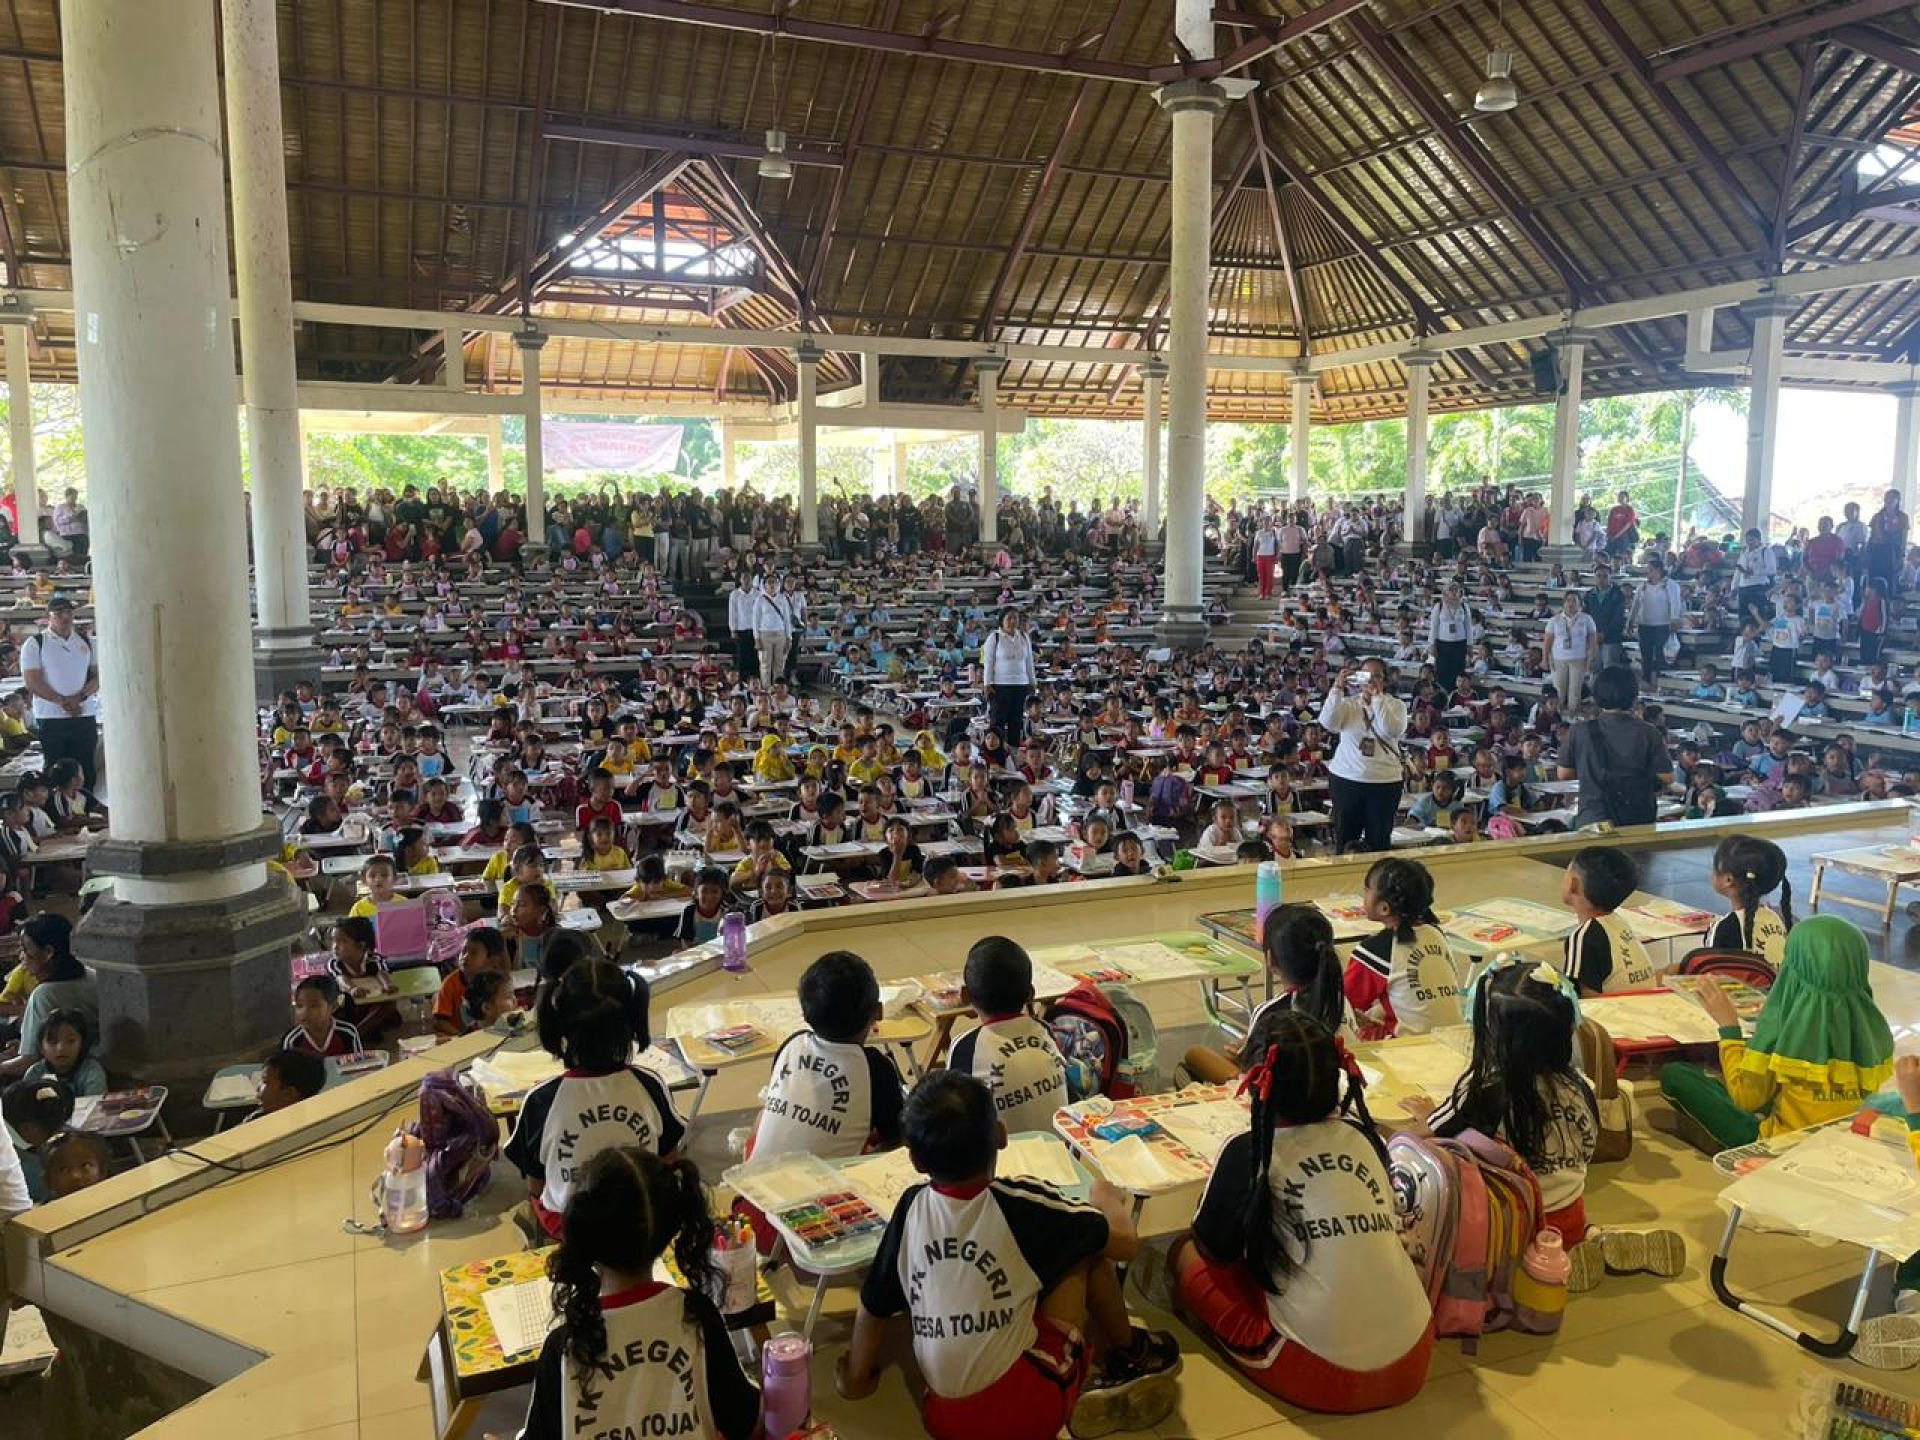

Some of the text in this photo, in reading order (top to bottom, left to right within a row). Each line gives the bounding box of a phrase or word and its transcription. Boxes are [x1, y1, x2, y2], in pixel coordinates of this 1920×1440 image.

[798, 1055, 850, 1113] NEGERI
[996, 1086, 1034, 1110] DESA
[558, 1104, 650, 1161] TK NEGERI
[792, 1104, 841, 1134] TOJAN
[1284, 1153, 1384, 1216] TK NEGERI
[1294, 1217, 1345, 1242] DESA
[910, 1238, 1012, 1305] TK NEGERI
[913, 1308, 1013, 1339] DESA TOJAN
